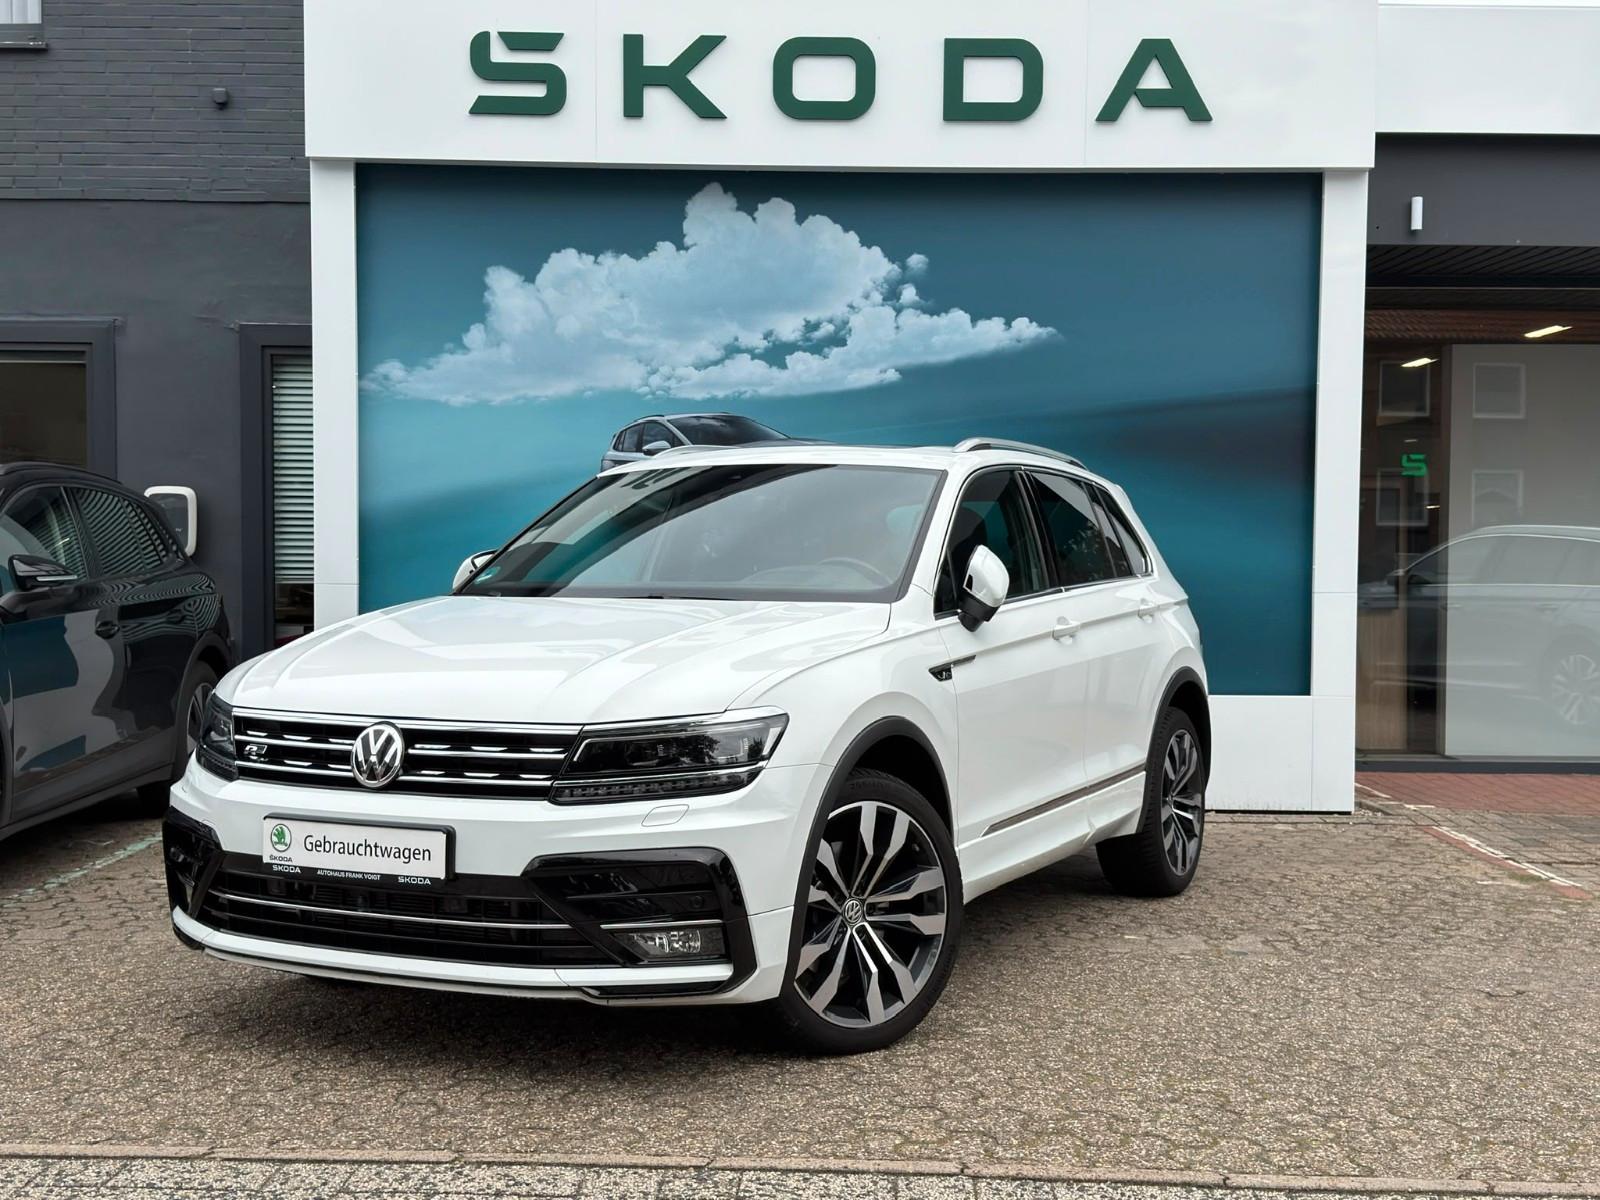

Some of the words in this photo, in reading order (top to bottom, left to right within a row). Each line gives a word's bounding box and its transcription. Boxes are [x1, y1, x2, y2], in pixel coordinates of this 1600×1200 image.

[303, 834, 432, 864] Gebrauchtwagen
[317, 869, 346, 878] AUTOHAUS
[364, 873, 381, 881] VOIGT
